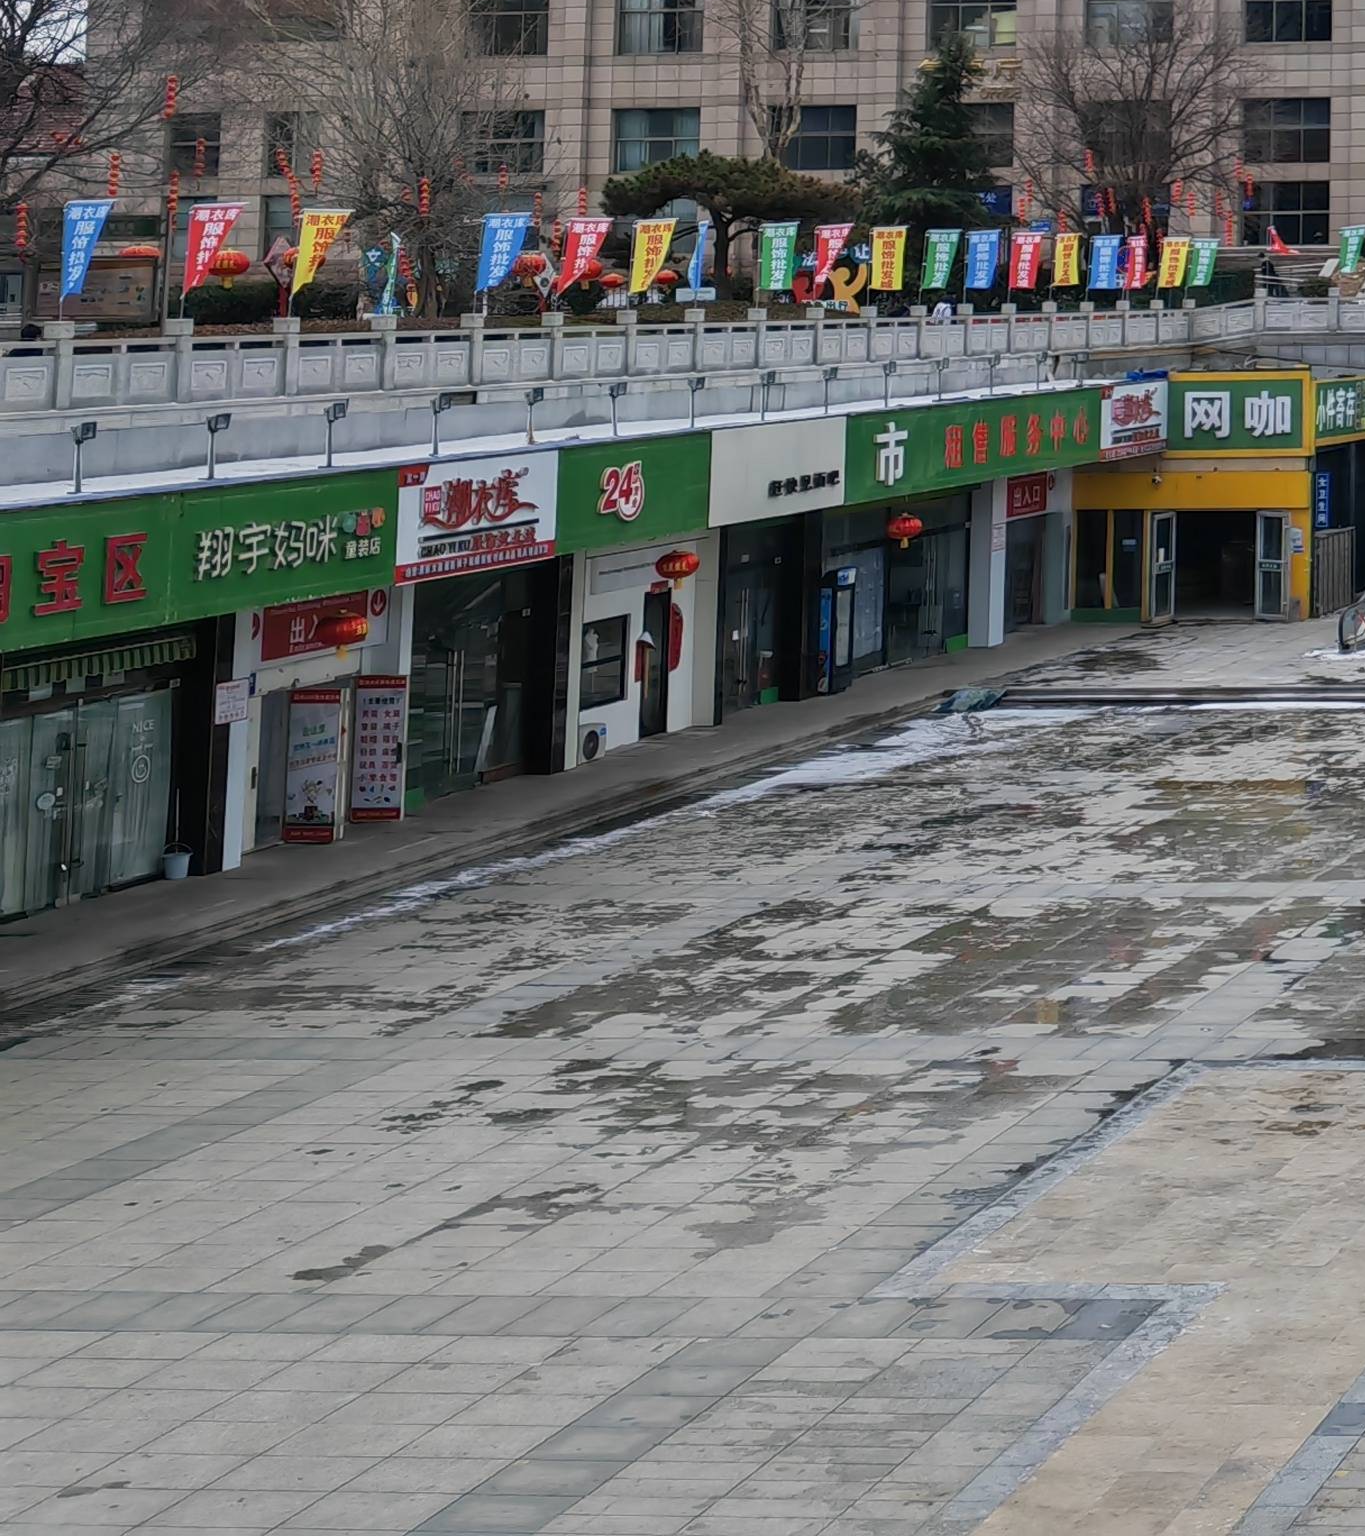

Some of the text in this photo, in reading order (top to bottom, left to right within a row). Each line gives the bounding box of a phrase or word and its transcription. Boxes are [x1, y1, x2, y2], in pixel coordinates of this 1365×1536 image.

[572, 222, 608, 233] 潮衣库
[769, 237, 788, 289] 服饰批发城
[879, 240, 897, 289] 服饰批发城
[944, 407, 1089, 469] 租售服务中心
[1184, 390, 1292, 439] 网咖
[874, 422, 908, 486] 市
[602, 467, 634, 511] 24
[1013, 485, 1041, 507] 出入口
[197, 514, 338, 581] 翔宇妈咪
[344, 537, 382, 560] 童装店
[132, 719, 155, 732] NICE
